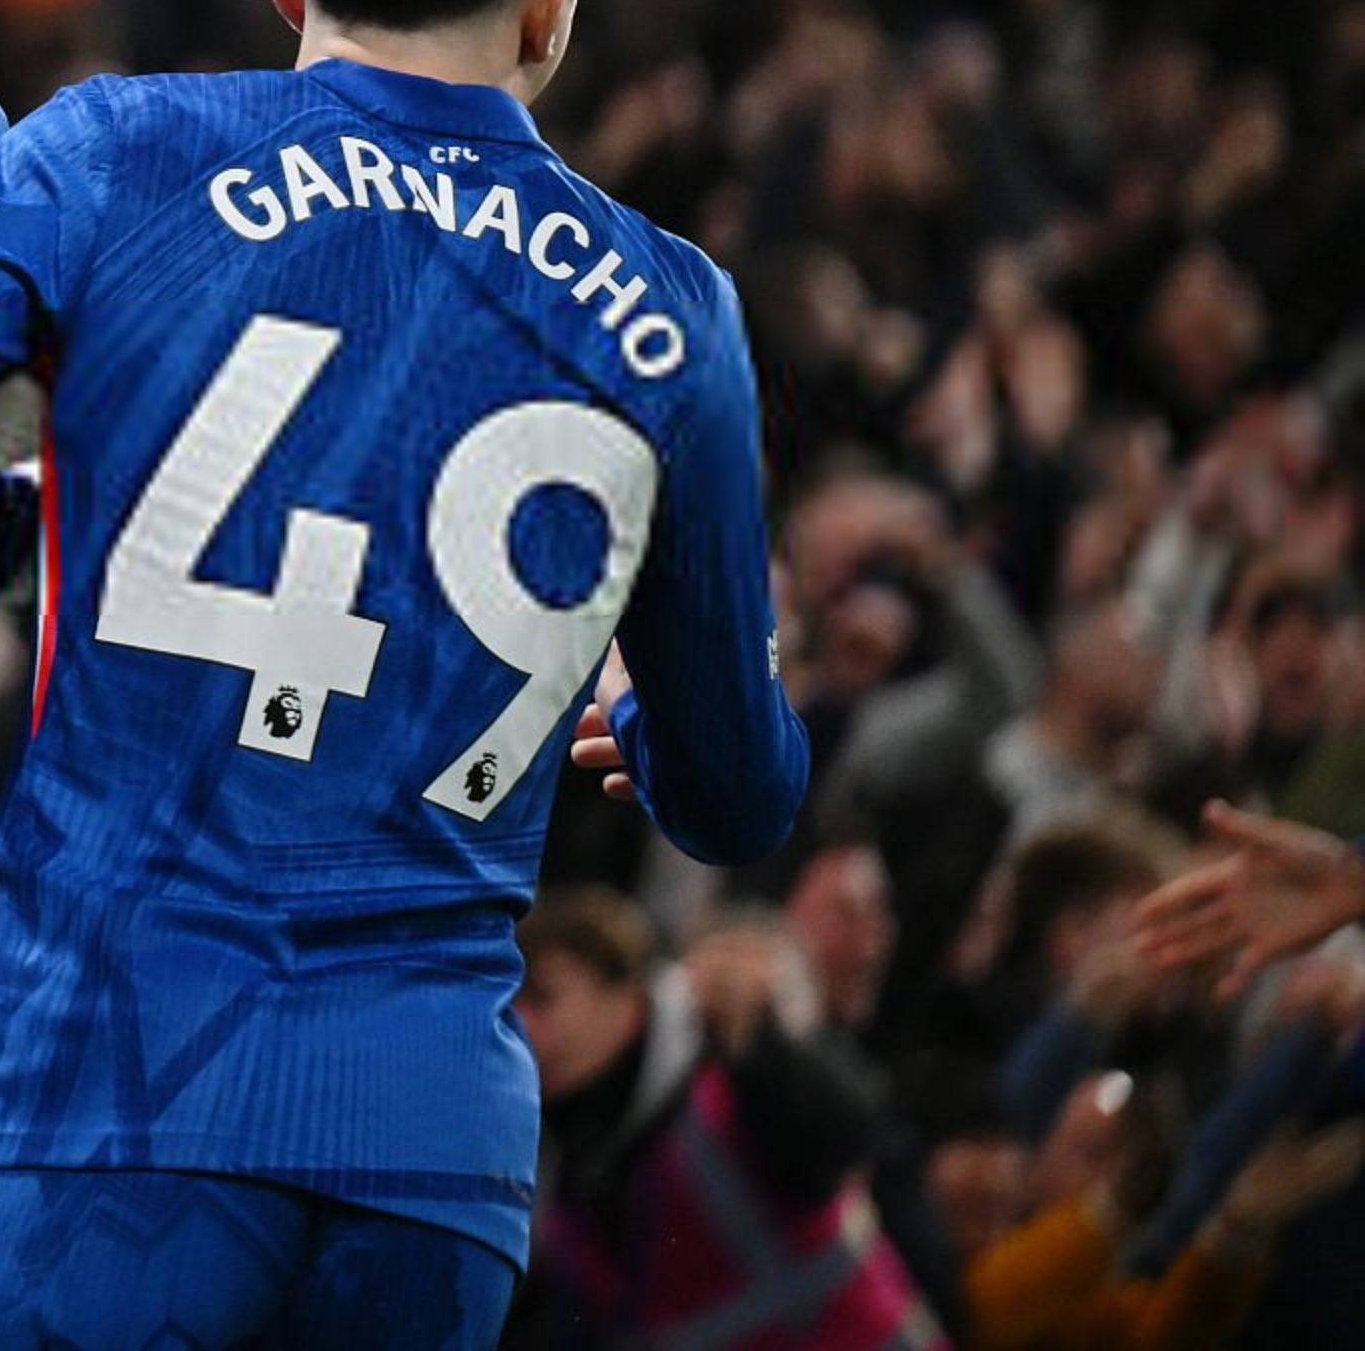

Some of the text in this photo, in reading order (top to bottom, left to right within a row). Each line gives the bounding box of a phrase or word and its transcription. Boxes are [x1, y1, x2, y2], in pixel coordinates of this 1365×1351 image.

[208, 136, 685, 378] GARNACHO
[429, 146, 480, 164] CFC
[94, 314, 661, 823] 49
